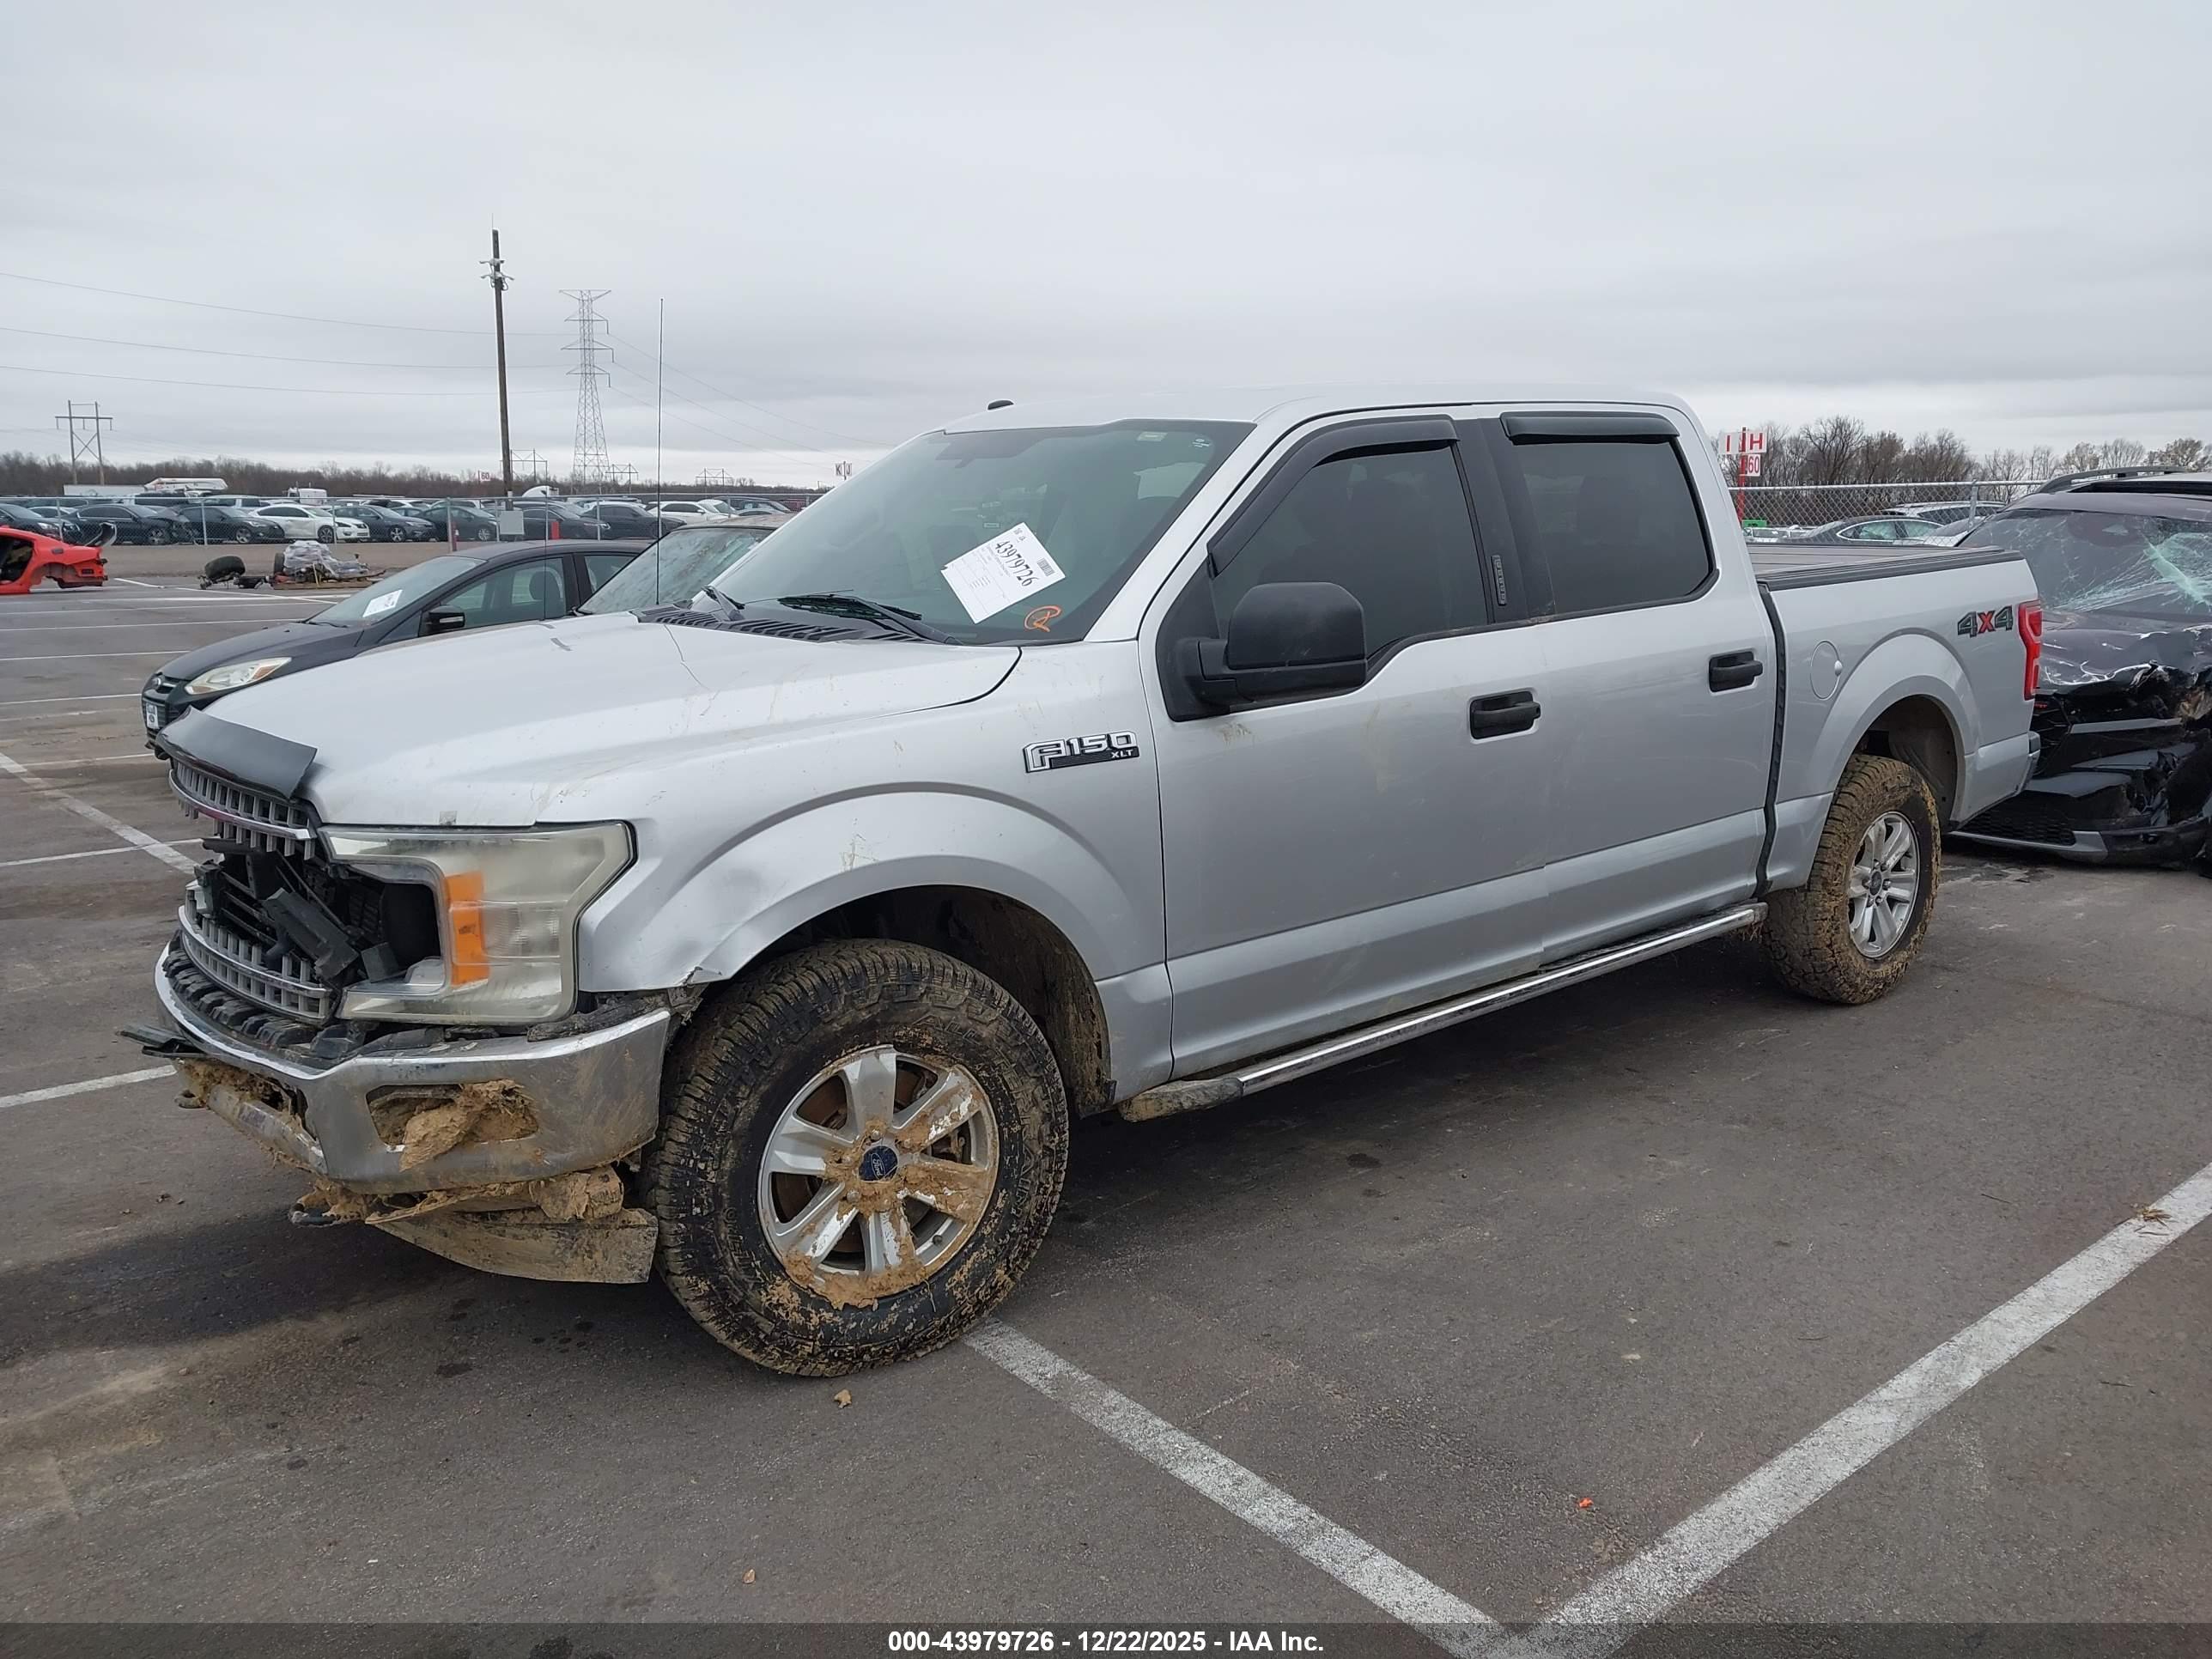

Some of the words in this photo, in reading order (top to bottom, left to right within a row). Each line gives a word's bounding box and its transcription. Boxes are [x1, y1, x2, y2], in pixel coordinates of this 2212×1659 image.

[1749, 432, 1764, 450] H
[836, 464, 842, 476] K
[847, 464, 852, 475] J
[1748, 456, 1759, 473] 60
[994, 539, 1041, 587] 43979726
[1110, 749, 1134, 759] XLT
[872, 1157, 884, 1177] Ford
